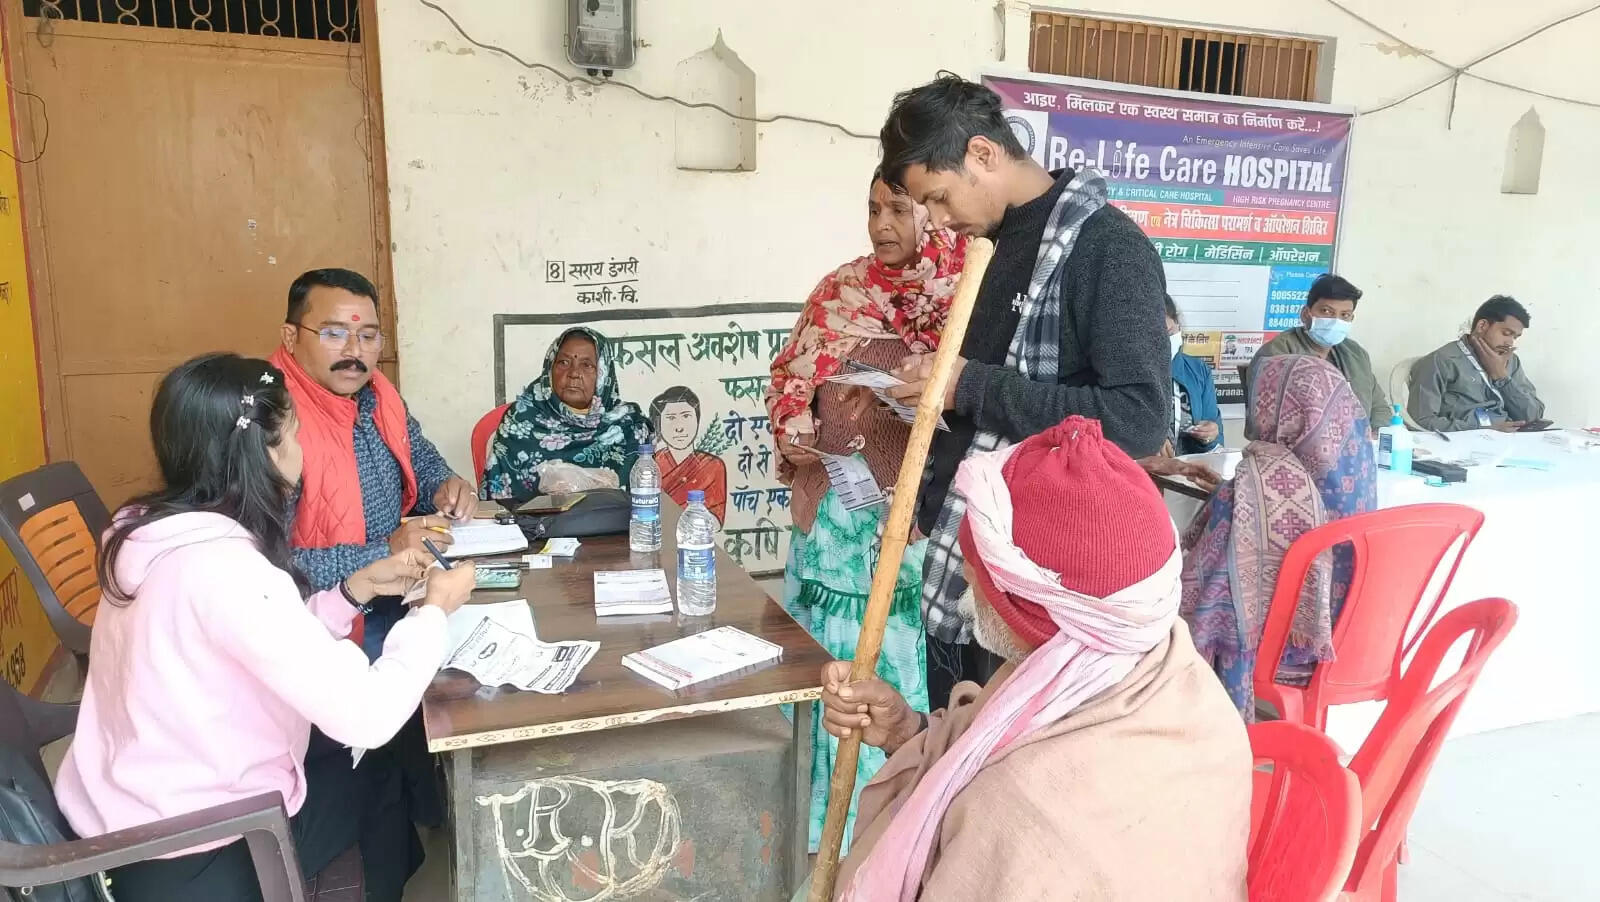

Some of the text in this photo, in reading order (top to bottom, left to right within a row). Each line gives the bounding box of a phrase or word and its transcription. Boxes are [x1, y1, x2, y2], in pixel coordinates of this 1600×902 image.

[1065, 93, 1116, 114] मिलकर
[1119, 102, 1140, 116] एक
[1143, 105, 1179, 121] स्वस्थ
[1182, 108, 1220, 124] समाज
[1223, 112, 1239, 126] का
[1242, 111, 1283, 130] निर्माण
[1182, 135, 1194, 144] An
[1196, 136, 1237, 148] Emergency
[1159, 146, 1217, 185] Care
[1222, 154, 1332, 193] HOSPITAL
[1125, 188, 1157, 199] CRITICAL
[1160, 190, 1179, 199] CARE
[1181, 192, 1213, 202] HOSPITAL
[1232, 194, 1331, 209] HIGH RISK PREGNANCY CENTRE
[1222, 212, 1253, 232] परामर्श
[1302, 215, 1329, 236] शिविर
[1165, 242, 1189, 257] रोग
[1204, 244, 1254, 260] मेडिसिन
[1269, 247, 1321, 263] ऑपरेशन
[549, 262, 560, 279] 8
[568, 262, 605, 280] सराय
[1271, 290, 1309, 301] 9005522
[687, 320, 762, 367] अवशेष
[737, 444, 772, 480] दो से
